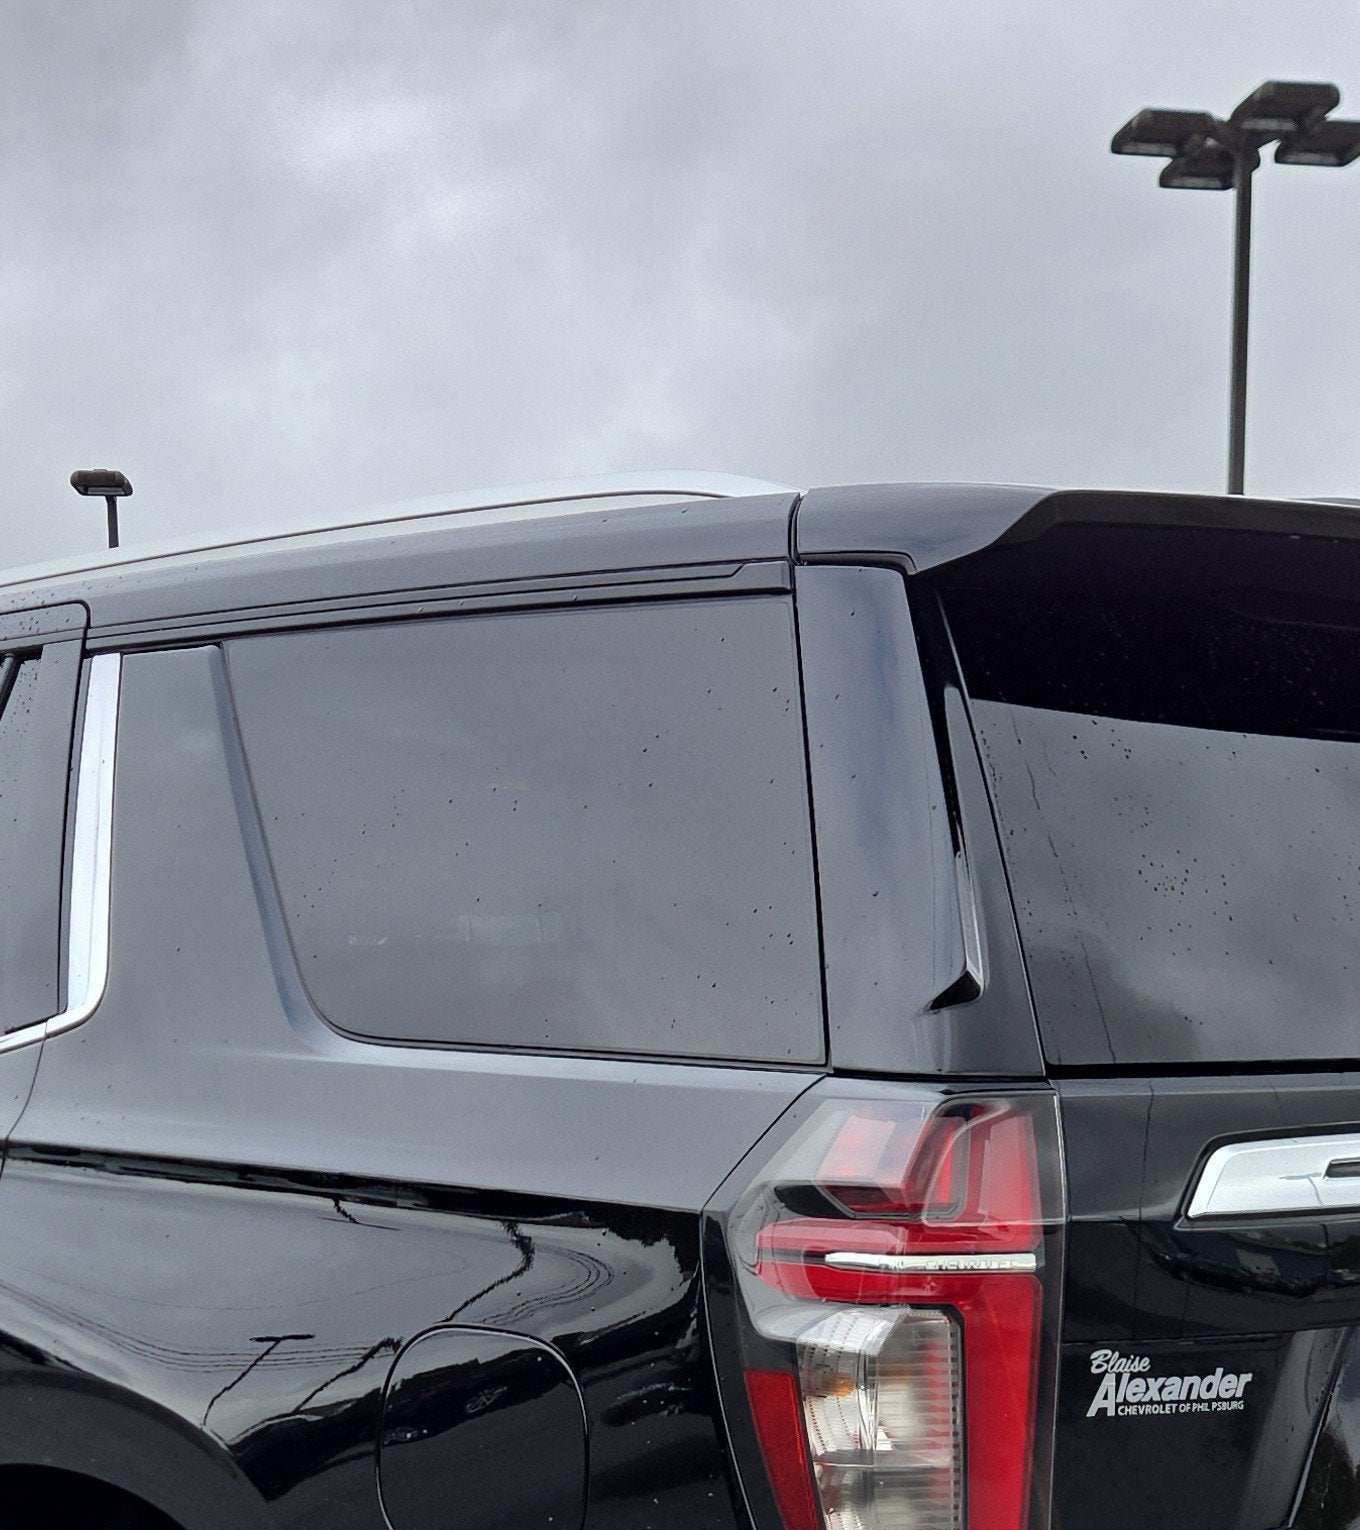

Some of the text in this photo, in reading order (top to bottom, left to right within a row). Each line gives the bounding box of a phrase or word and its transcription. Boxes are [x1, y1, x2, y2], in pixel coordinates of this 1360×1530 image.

[1089, 1348, 1152, 1374] Blaise
[1086, 1367, 1253, 1418] Alexander
[1117, 1403, 1178, 1416] CHEVROLET
[1178, 1402, 1192, 1413] OF
